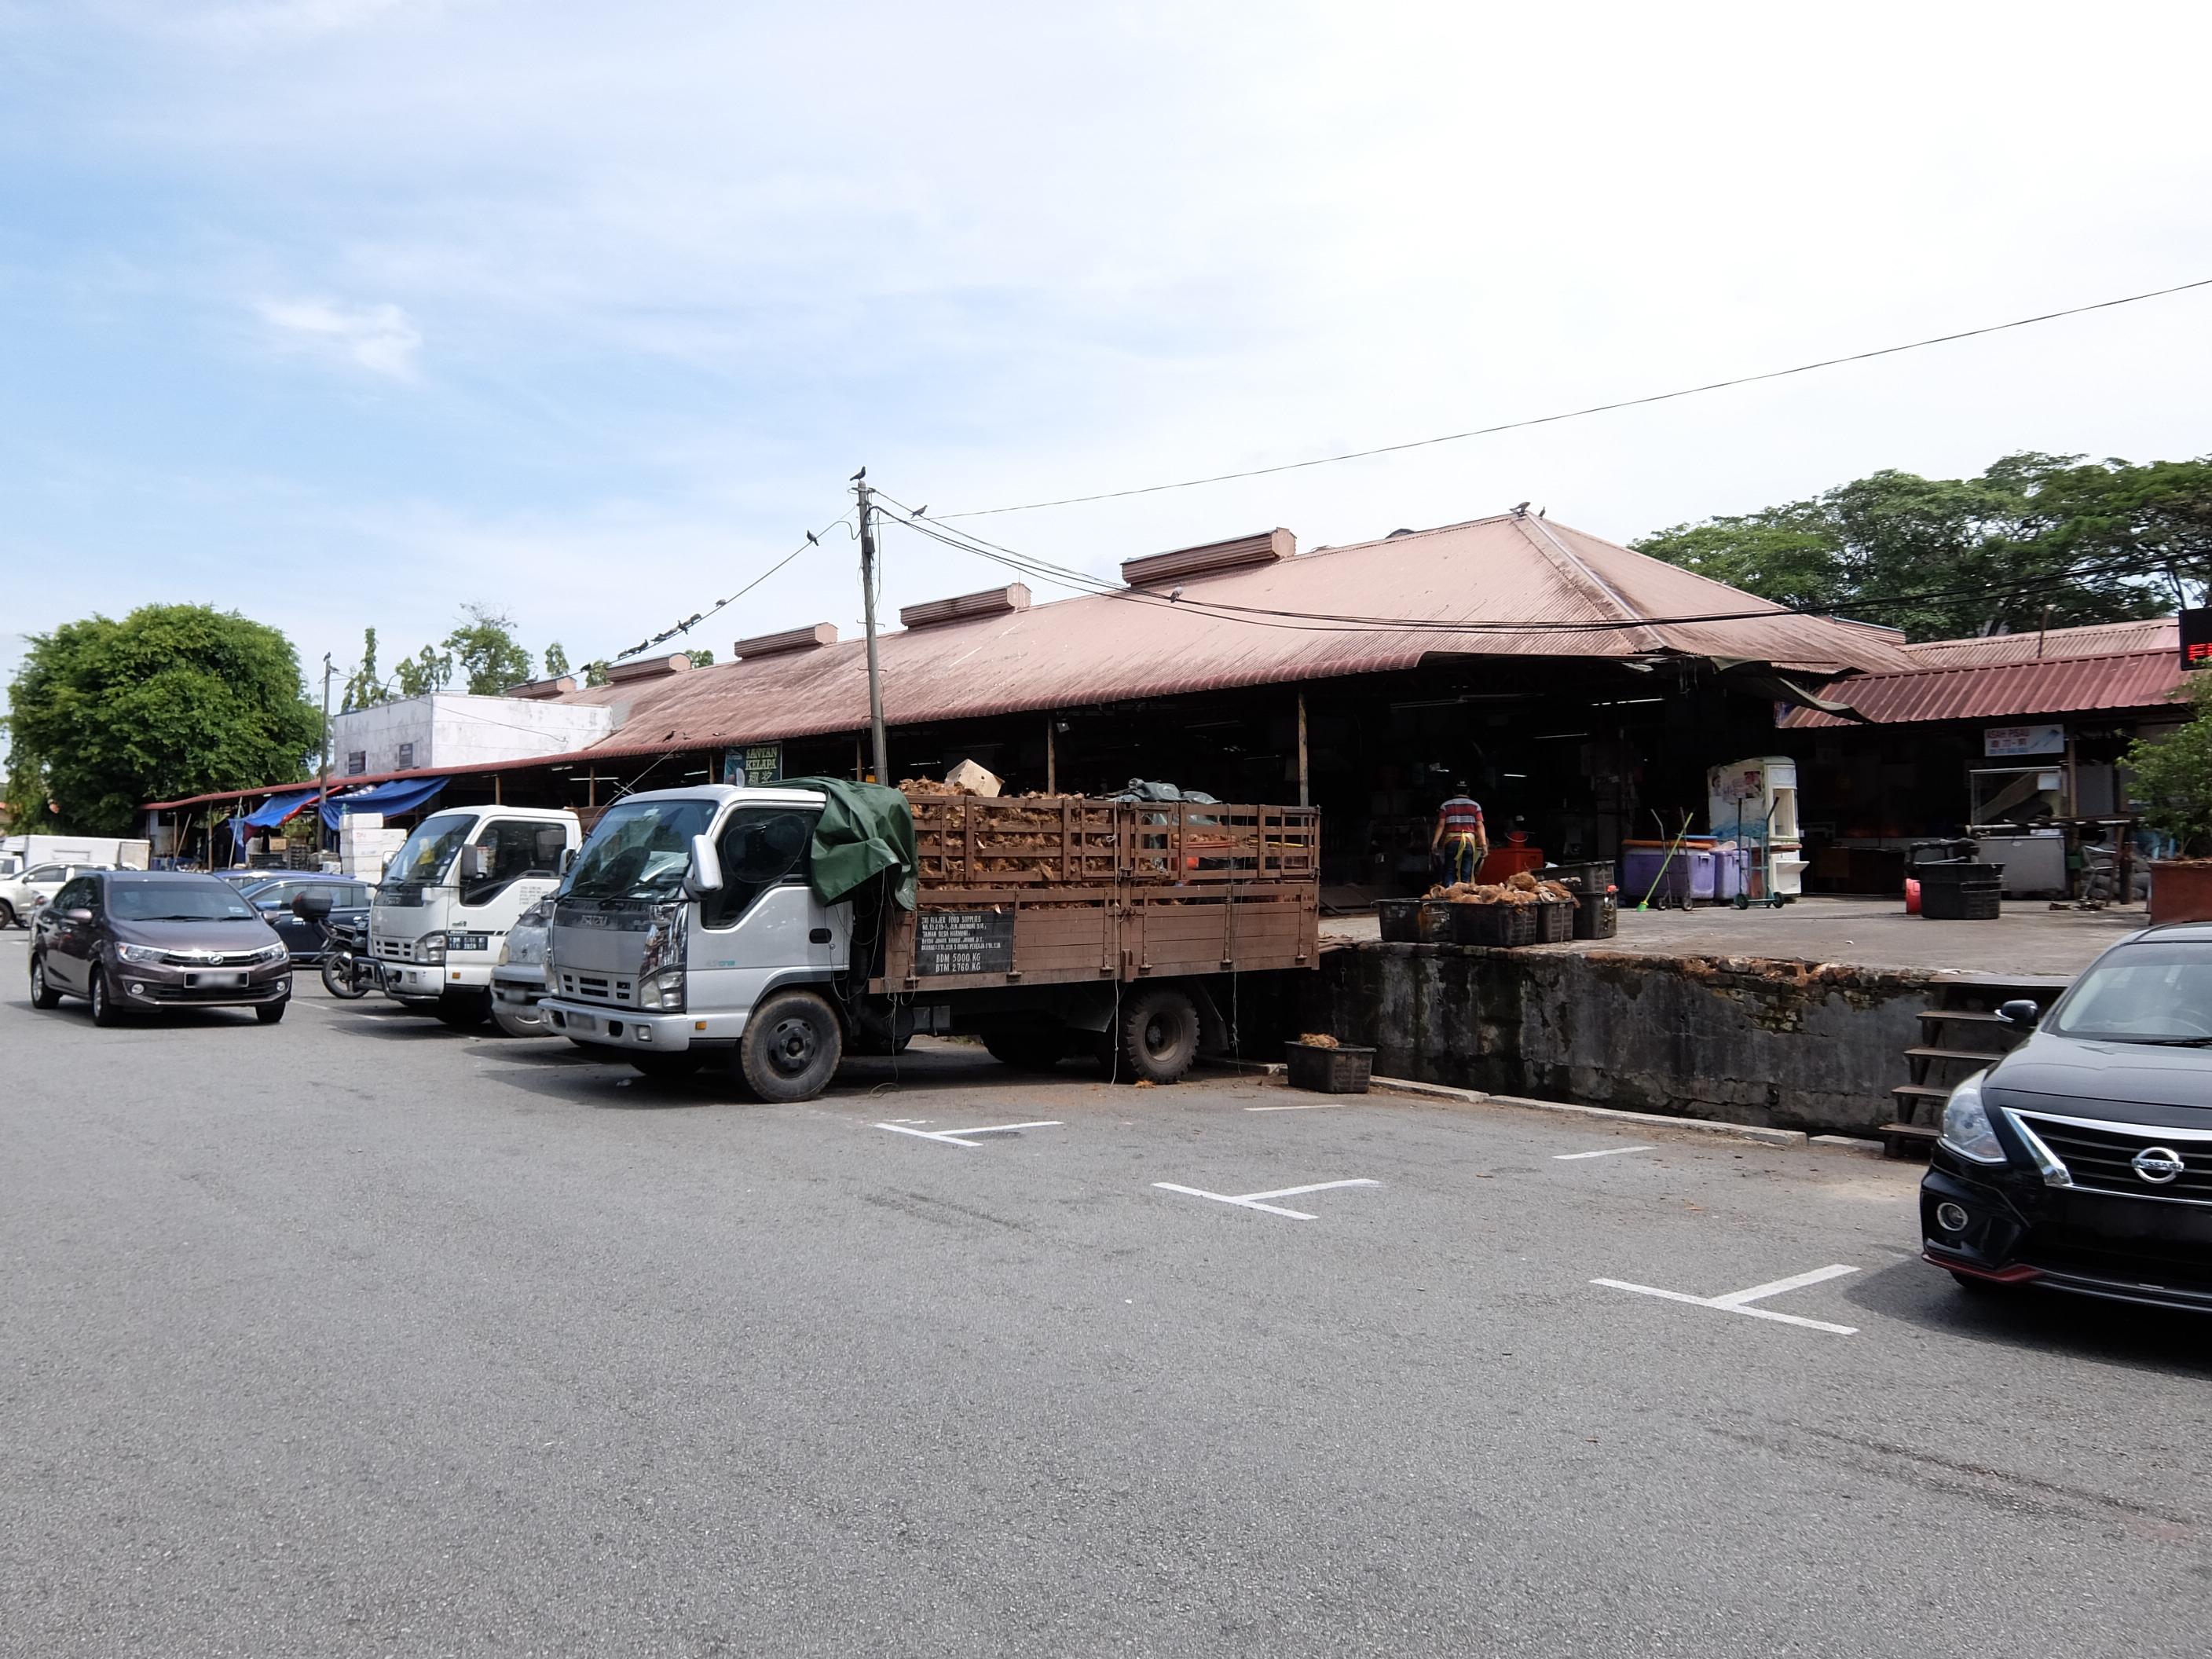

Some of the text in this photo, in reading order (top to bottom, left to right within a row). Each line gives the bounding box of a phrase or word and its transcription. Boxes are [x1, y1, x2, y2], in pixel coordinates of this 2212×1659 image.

[746, 748, 778, 759] SANTAN
[745, 759, 777, 771] KELAPA
[936, 952, 981, 964] BDM 5000 KG
[936, 962, 980, 973] BTM 2760 KG
[2134, 1160, 2183, 1170] NISSAN
